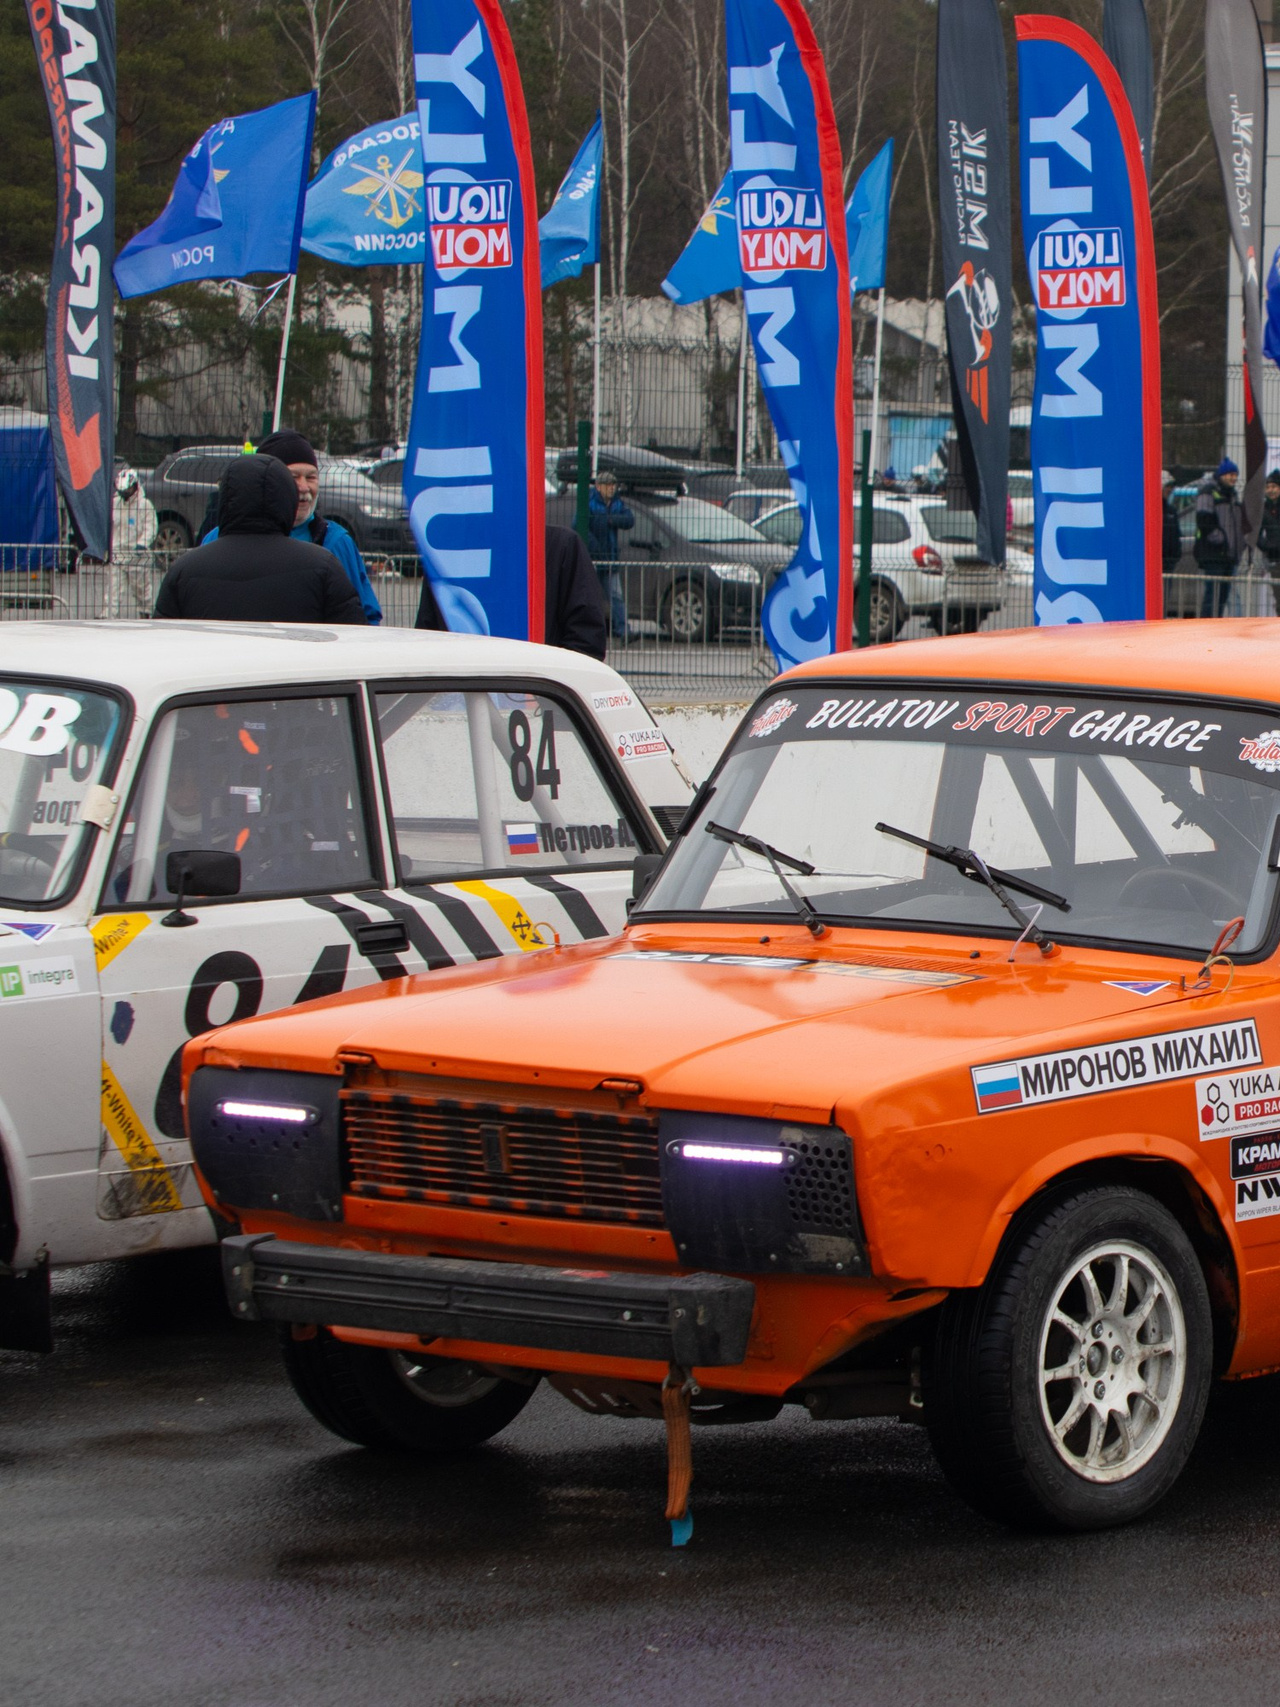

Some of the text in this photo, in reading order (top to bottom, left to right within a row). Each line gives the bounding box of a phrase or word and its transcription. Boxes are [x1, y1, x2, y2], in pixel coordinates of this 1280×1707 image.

[806, 698, 1222, 752] BULATOV SPORT GARAGE
[628, 730, 650, 743] YUKA
[508, 709, 561, 802] 84
[636, 745, 649, 754] PRO
[540, 822, 615, 854] Петров
[27, 968, 74, 986] integra
[1020, 1026, 1258, 1099] МИРОНОВ МИХАИЛ
[1229, 1073, 1275, 1098] YUKA
[1239, 1103, 1262, 1118] PRO
[1237, 1209, 1256, 1218] NIPPON
[1256, 1206, 1272, 1215] WIPER
